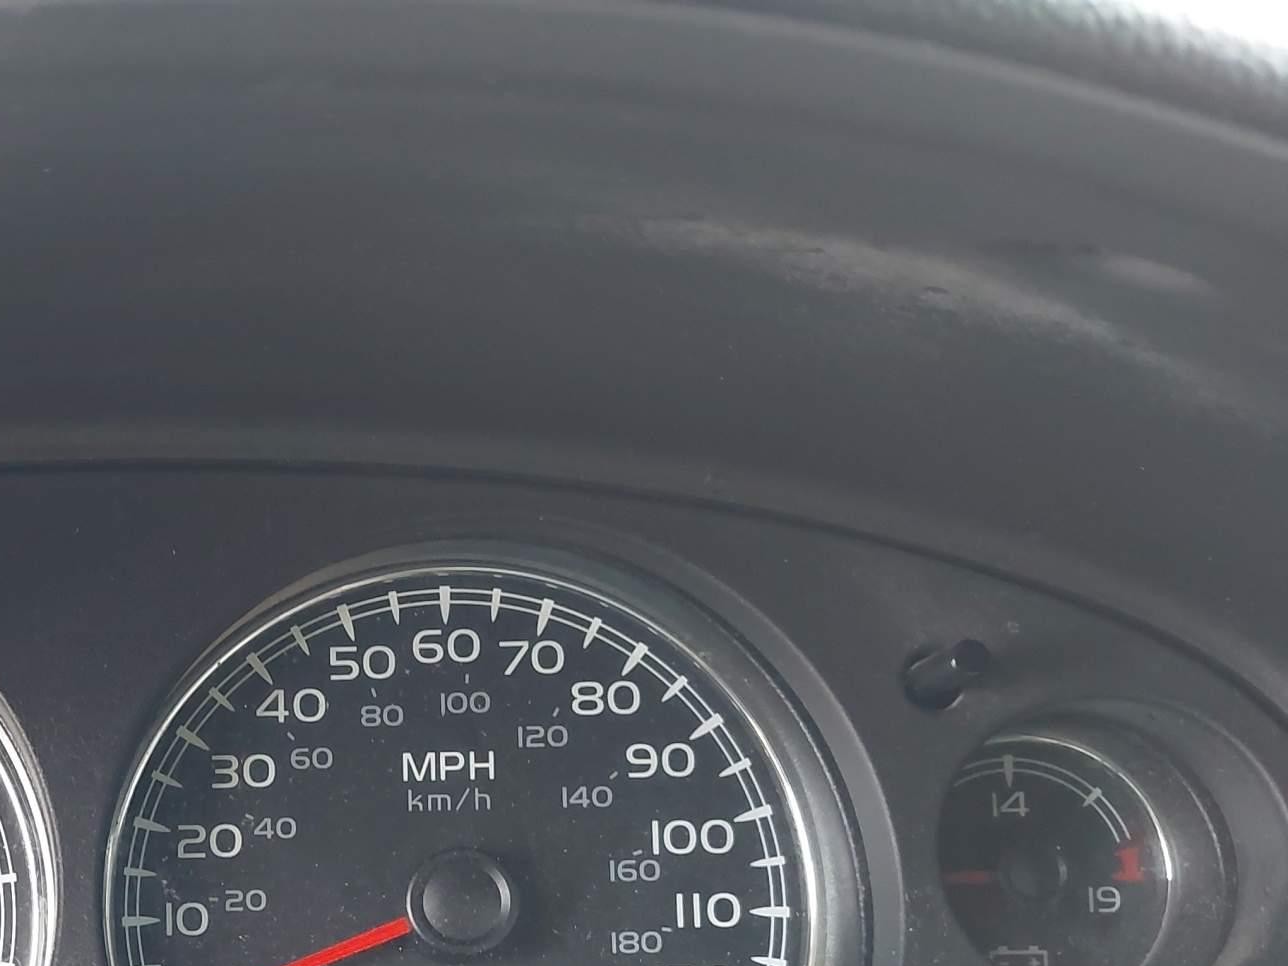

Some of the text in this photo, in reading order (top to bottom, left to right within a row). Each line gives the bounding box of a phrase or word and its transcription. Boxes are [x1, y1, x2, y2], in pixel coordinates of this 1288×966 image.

[412, 628, 481, 664] 60
[498, 640, 565, 676] 70
[329, 645, 396, 681] 50
[256, 688, 326, 723] 40
[440, 691, 491, 717] 100
[571, 680, 641, 716] 80
[360, 703, 404, 727] 80
[517, 725, 568, 748] 120
[212, 754, 276, 788] 30
[290, 747, 333, 770] 60
[402, 750, 495, 782] MPH
[625, 742, 695, 778] 90
[407, 787, 491, 812] km/h
[561, 785, 613, 809] 140
[991, 791, 1030, 817] 14
[177, 823, 243, 858] 20
[253, 817, 297, 839] 40
[651, 819, 734, 855] 100
[609, 859, 661, 882] 160
[225, 889, 267, 912] 20
[676, 892, 741, 929] 110
[1088, 886, 1121, 913] 19
[165, 902, 210, 936] 10
[611, 931, 662, 954] 180
